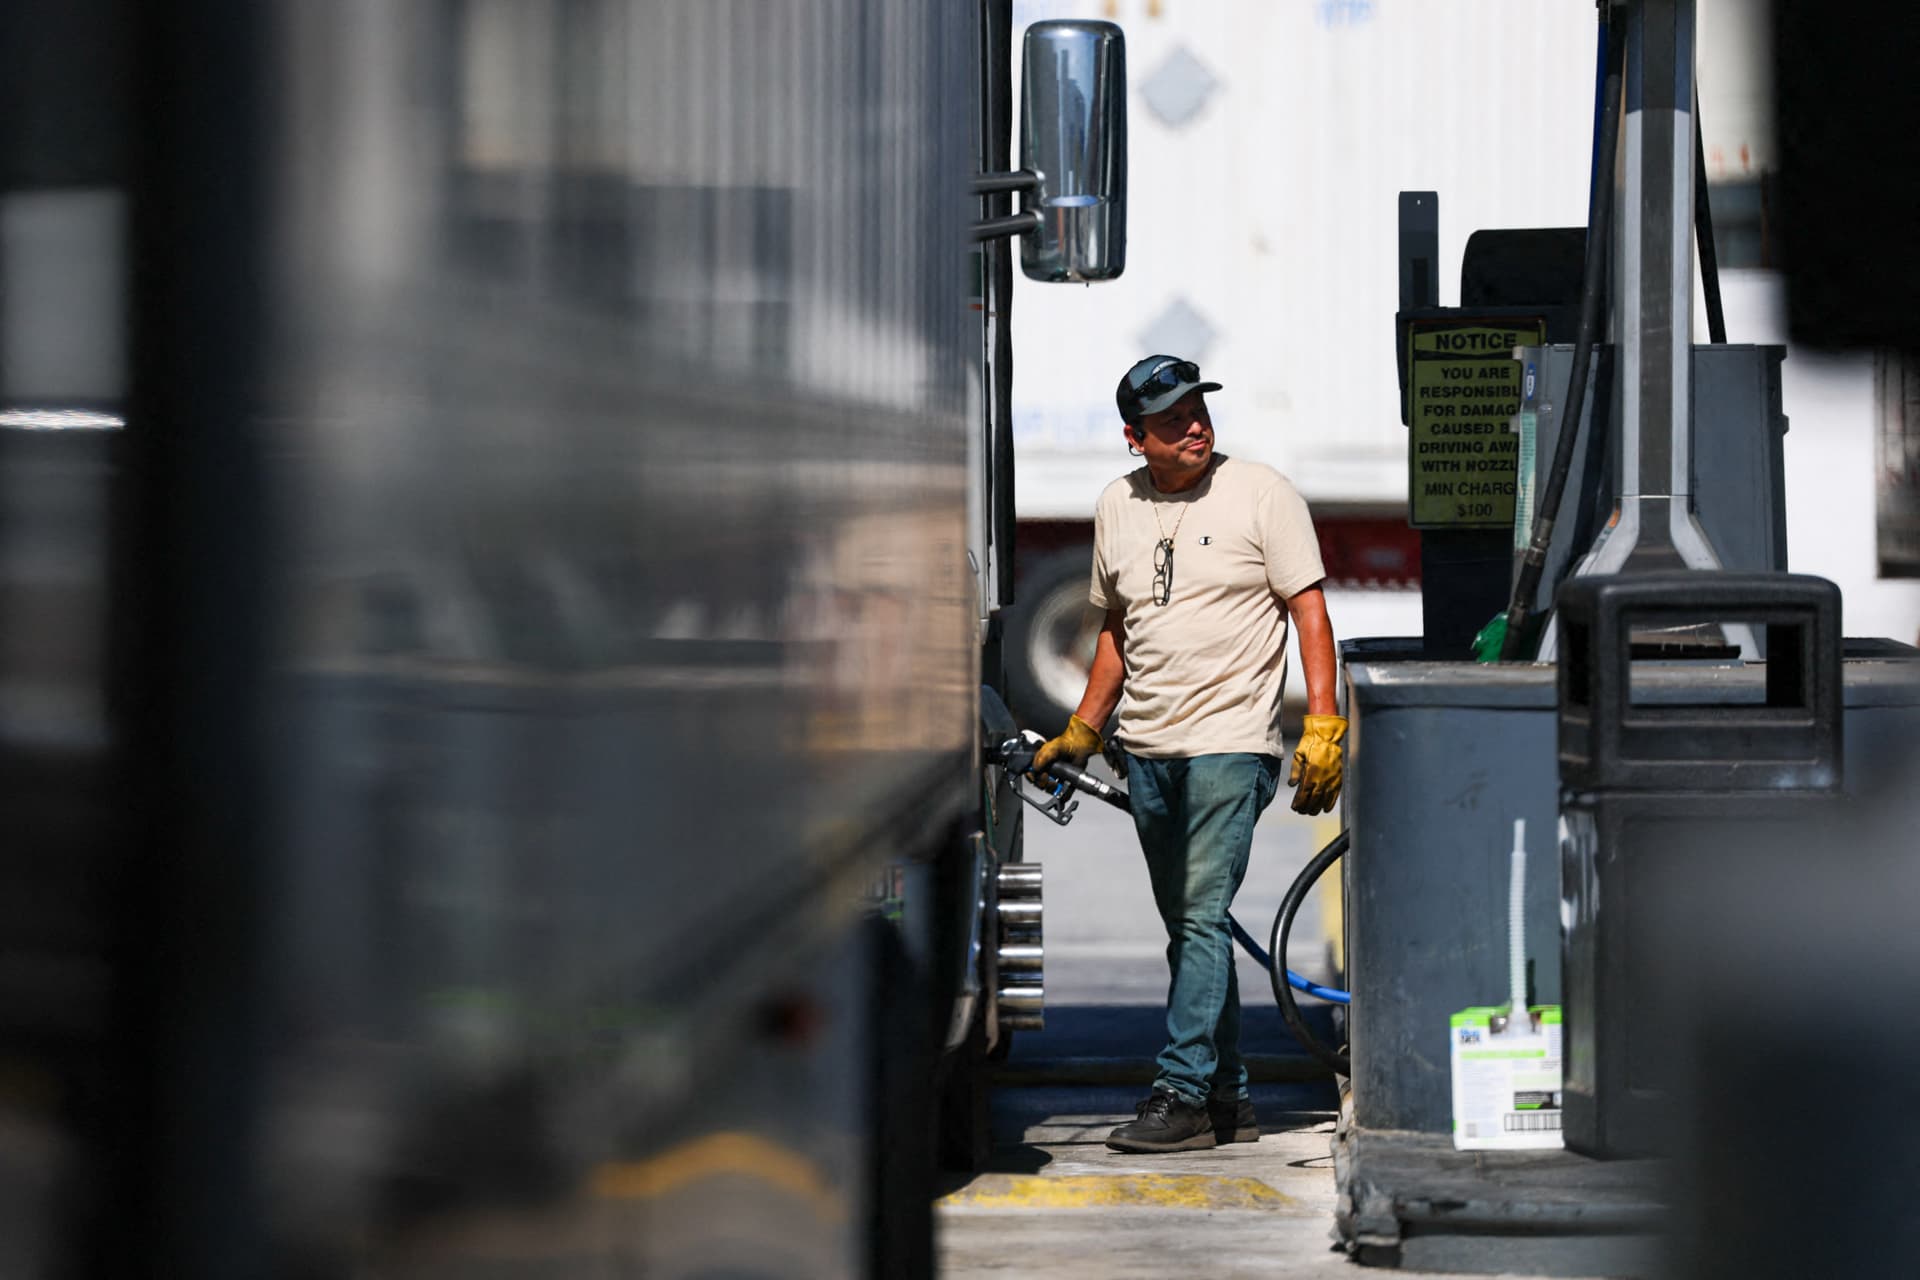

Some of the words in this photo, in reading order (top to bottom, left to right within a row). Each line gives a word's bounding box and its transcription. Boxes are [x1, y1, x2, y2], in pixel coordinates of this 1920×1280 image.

[1436, 333, 1517, 349] NOTICE
[1441, 367, 1473, 379] YOU
[1478, 367, 1510, 379] ARE
[1420, 386, 1520, 398] RESPONSIBL
[1424, 405, 1455, 416] FOR
[1461, 404, 1516, 416] DAMAG
[1431, 423, 1494, 434] CAUSED
[1500, 423, 1510, 434] B
[1419, 442, 1484, 453] DRIVING
[1488, 441, 1517, 453] AW
[1422, 461, 1460, 472] WITH
[1466, 460, 1515, 472] NOZZL
[1425, 483, 1453, 496] MIN
[1458, 482, 1514, 496] CHARG
[1457, 503, 1493, 517] $100
